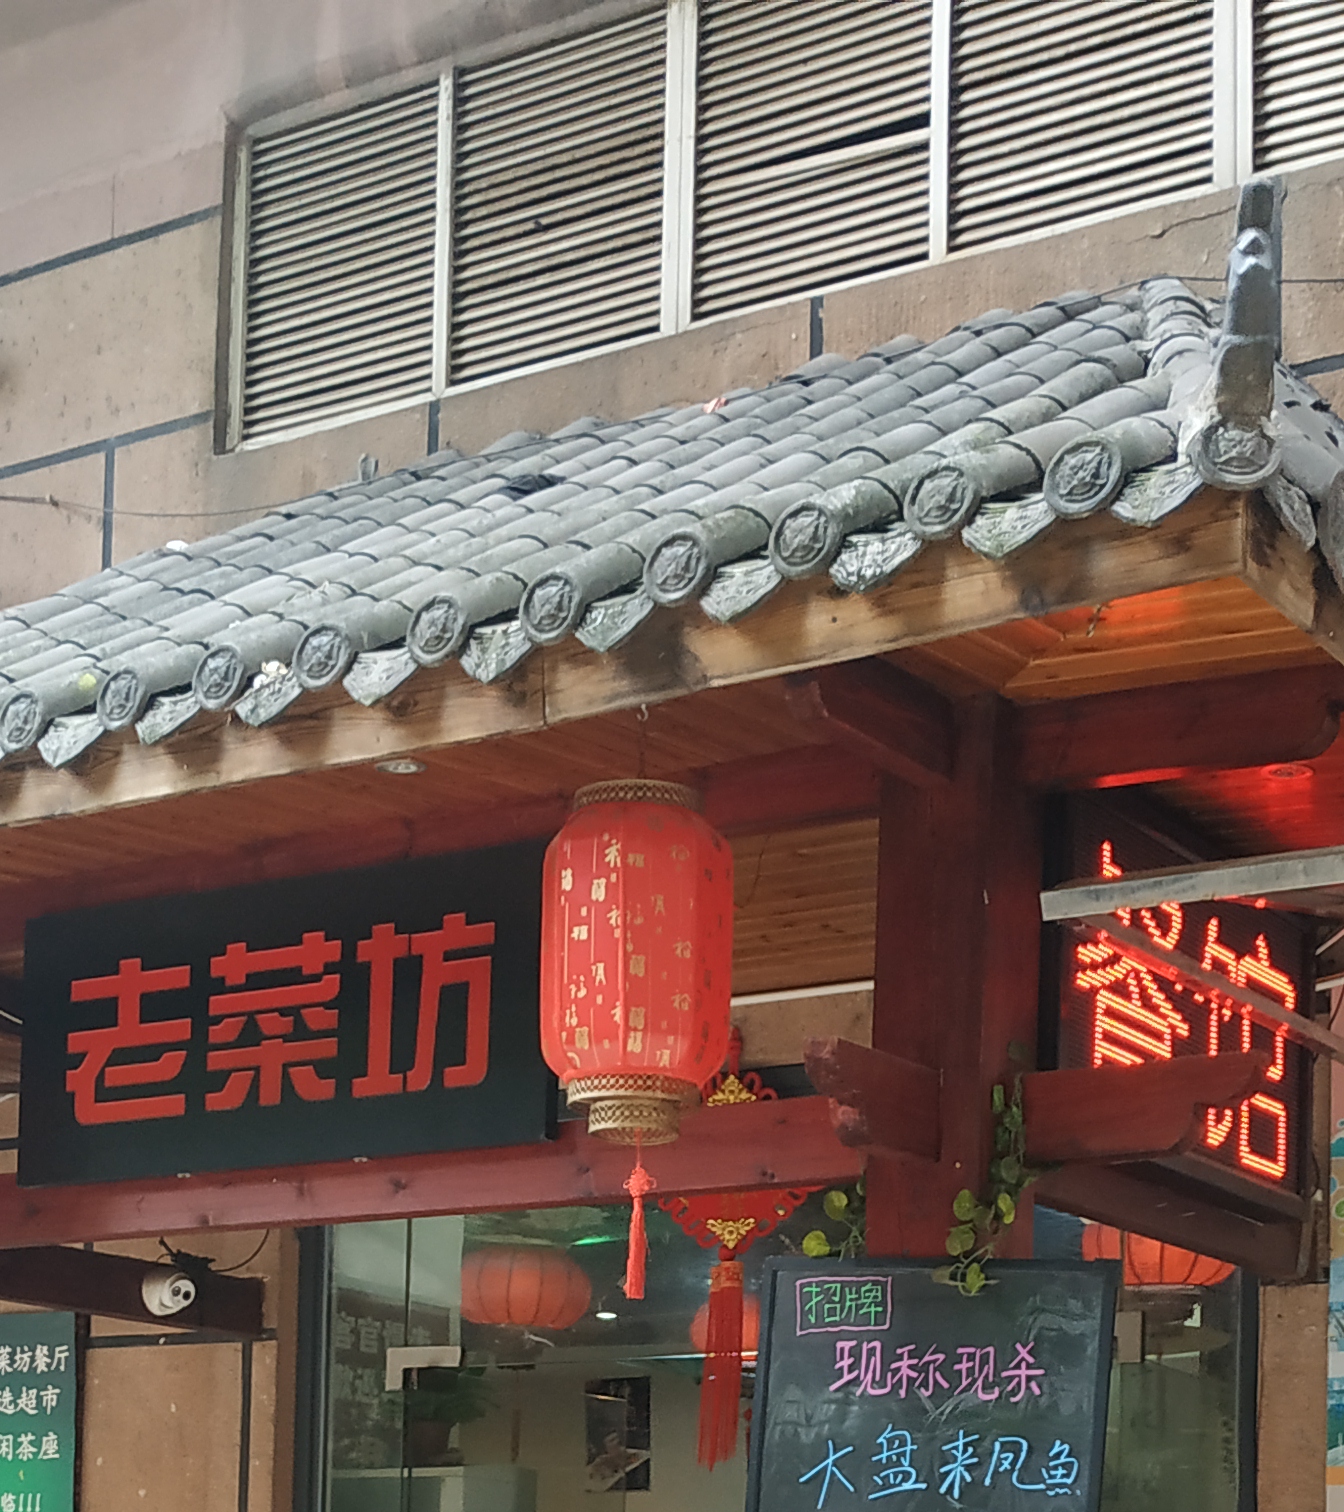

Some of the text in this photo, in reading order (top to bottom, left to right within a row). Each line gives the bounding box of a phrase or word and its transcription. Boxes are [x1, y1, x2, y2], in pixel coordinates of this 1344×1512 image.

[66, 912, 495, 1126] 老菜坊
[802, 1281, 885, 1327] 招牌
[828, 1340, 1046, 1403] 现称现杀
